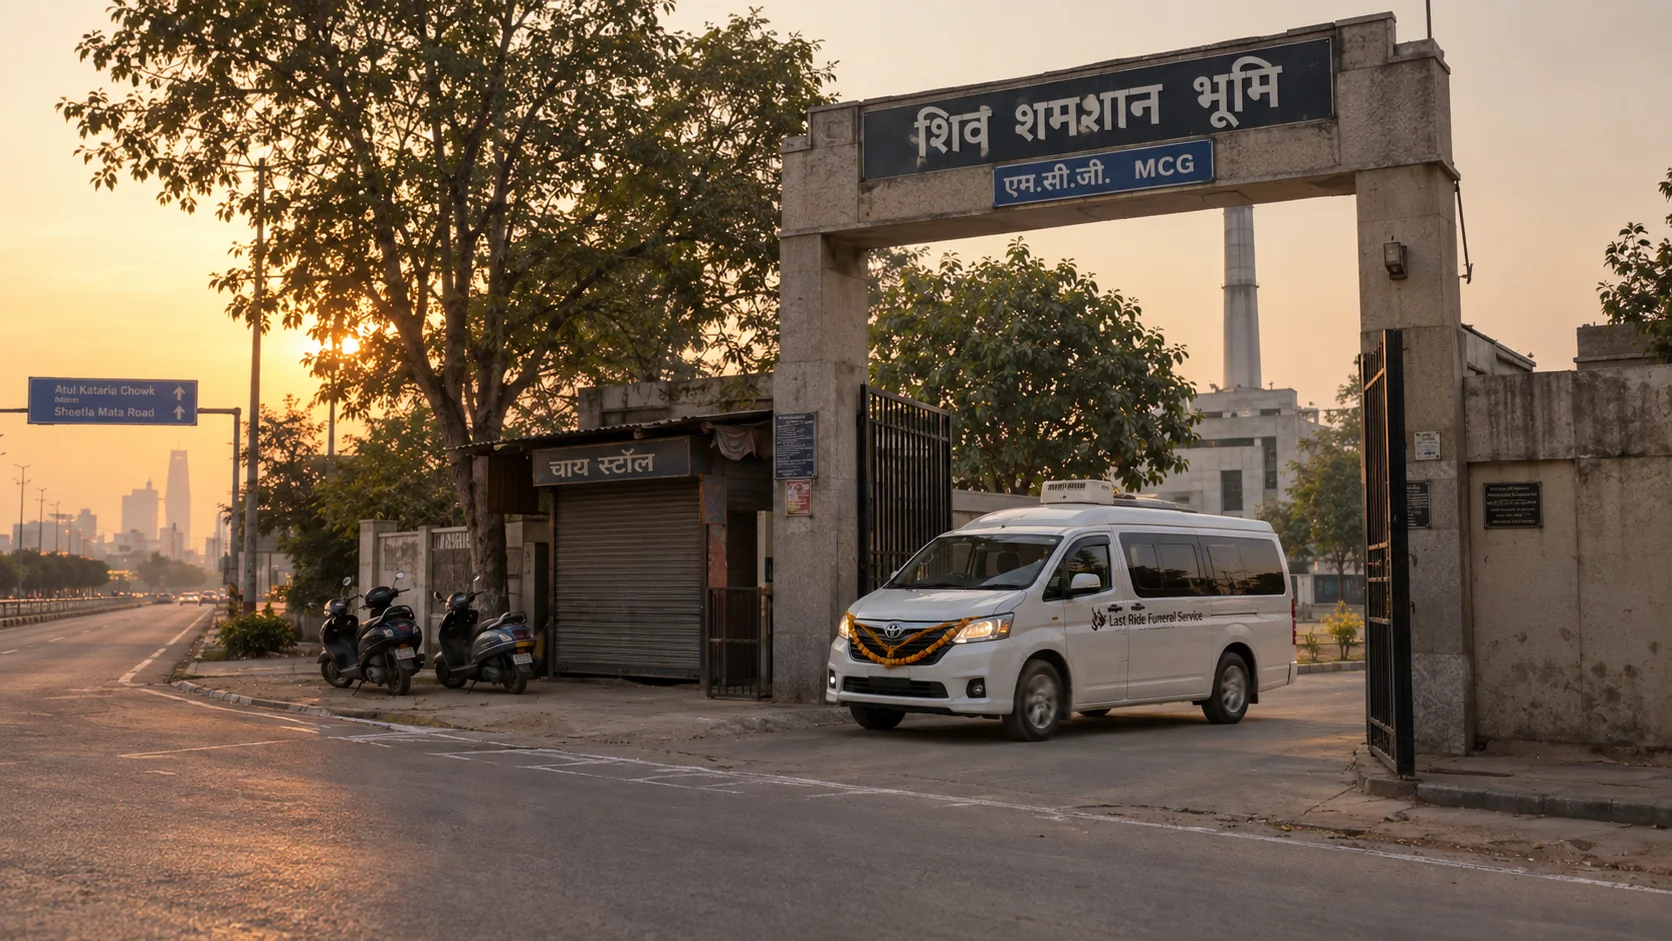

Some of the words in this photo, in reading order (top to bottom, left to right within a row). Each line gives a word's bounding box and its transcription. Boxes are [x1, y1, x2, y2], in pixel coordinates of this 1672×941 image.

[913, 105, 993, 156] शिव
[1014, 83, 1164, 142] शमशान
[1192, 55, 1283, 129] भूमि
[1003, 158, 1111, 198] एम.सी.जी.
[1134, 153, 1195, 180] MCG
[54, 384, 77, 395] Atul
[79, 384, 118, 396] Kataria
[120, 385, 156, 396] Chowk
[54, 406, 95, 417] Sheetla
[98, 407, 124, 418] Mata
[127, 407, 155, 418] Road
[549, 458, 590, 478] चाय
[598, 448, 656, 475] स्टॉल
[1109, 614, 1127, 627] Last
[1128, 613, 1147, 626] Ride
[1148, 611, 1177, 625] Funeral
[1177, 610, 1203, 623] Service
